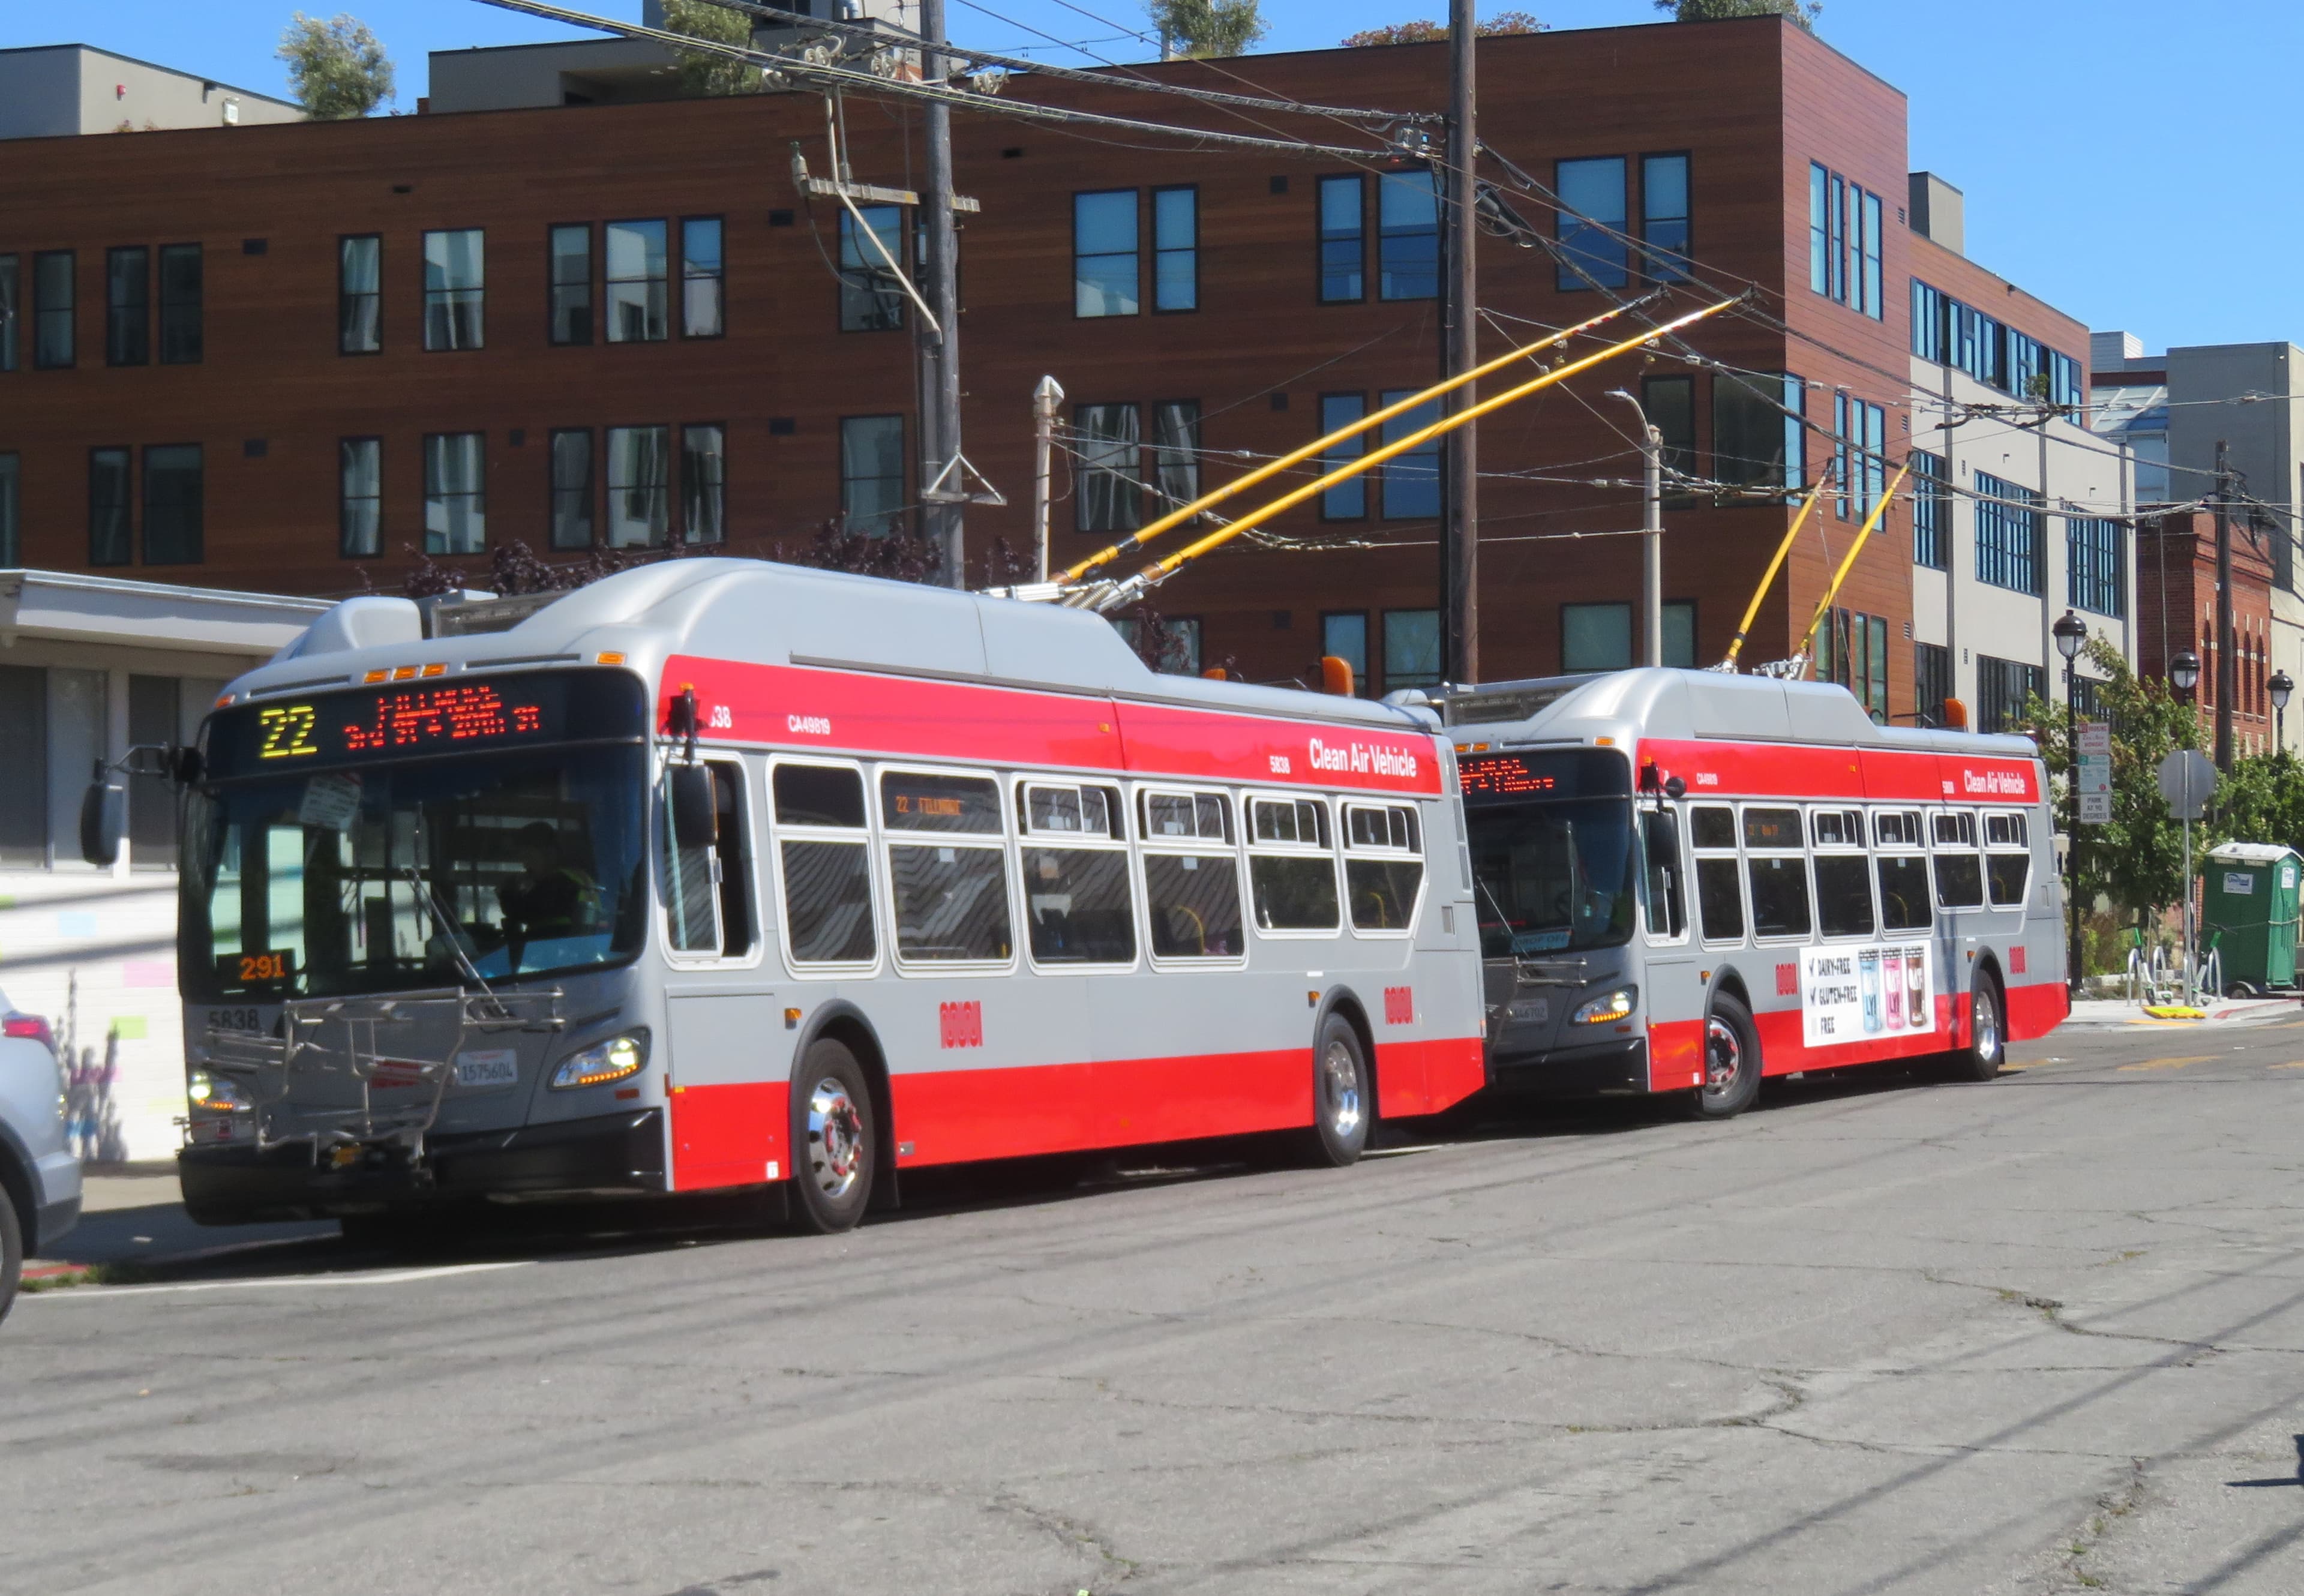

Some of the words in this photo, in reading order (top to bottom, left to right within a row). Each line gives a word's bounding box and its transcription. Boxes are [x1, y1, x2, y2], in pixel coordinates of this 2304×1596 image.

[260, 705, 317, 758] 22
[1269, 755, 1292, 775] 5838
[1309, 737, 1349, 772] Clean
[1350, 742, 1370, 773] Air
[1369, 743, 1418, 778] Vehicle
[1963, 769, 1987, 793] Clean
[1987, 771, 1998, 793] Air
[1997, 772, 2026, 794] Vehicle
[241, 954, 286, 980] 291
[1820, 1016, 1835, 1034] FREE
